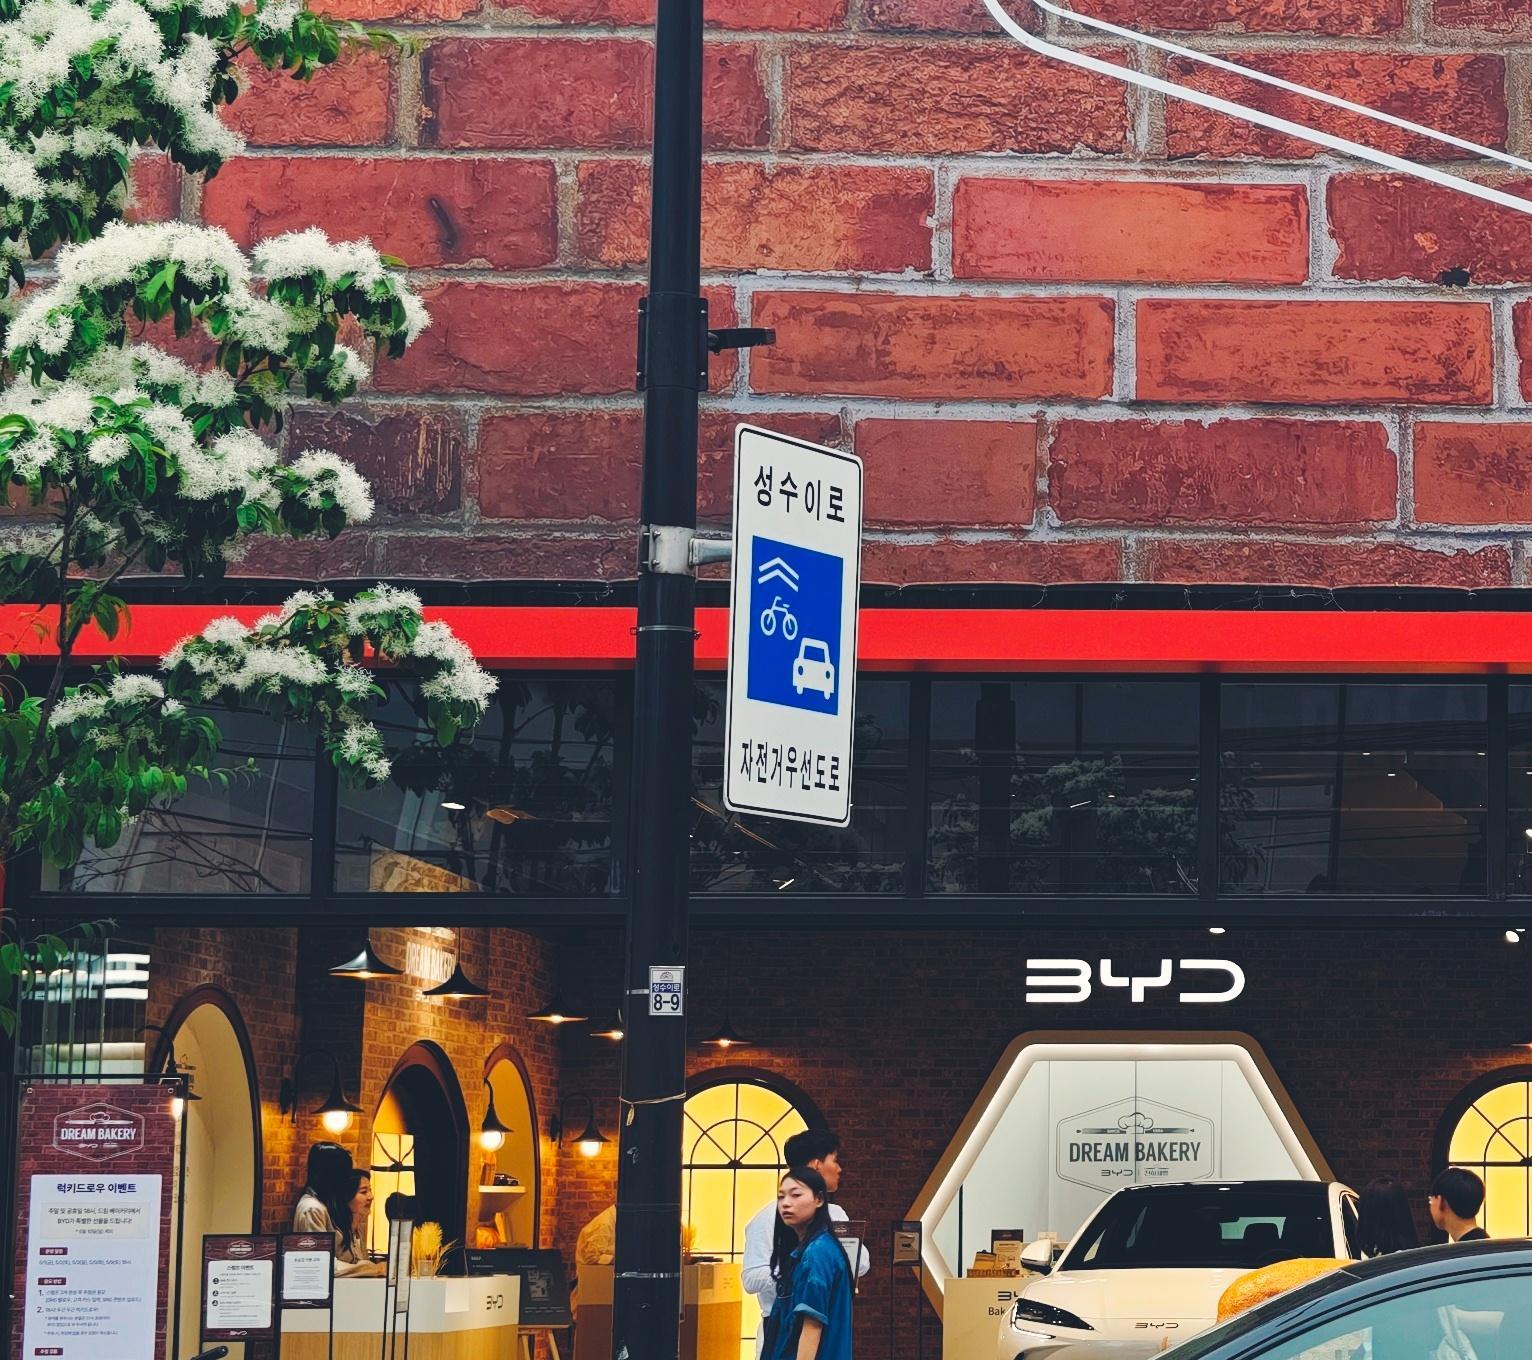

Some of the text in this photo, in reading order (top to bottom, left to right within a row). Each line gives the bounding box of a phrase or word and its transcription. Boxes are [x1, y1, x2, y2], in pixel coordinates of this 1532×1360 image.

[753, 463, 845, 524] 성수이로
[740, 739, 840, 792] 자전거우선도로
[652, 983, 681, 992] 성수이로
[1025, 958, 1246, 1003] BYD
[653, 993, 680, 1011] 8-9
[60, 1128, 137, 1141] DREAM BAKERY
[1069, 1141, 1201, 1163] DREAM BAKERY
[1101, 1169, 1134, 1177] BYD
[57, 1183, 137, 1193] 럭키드로우 이벤트
